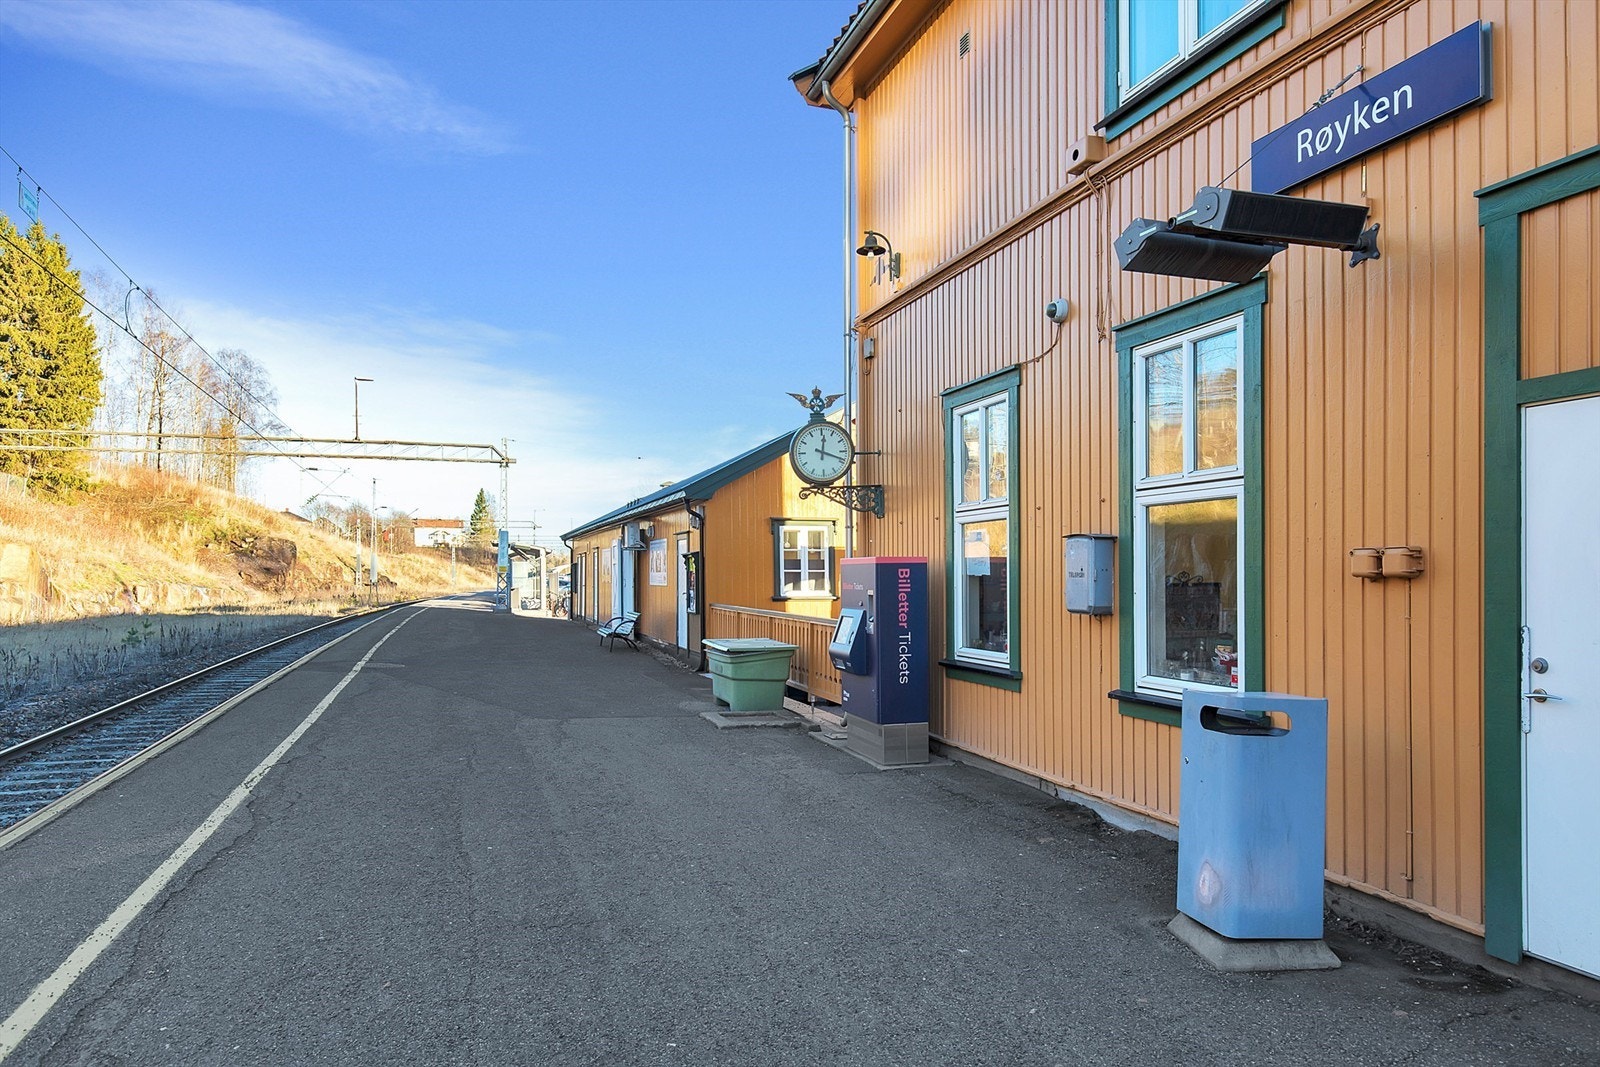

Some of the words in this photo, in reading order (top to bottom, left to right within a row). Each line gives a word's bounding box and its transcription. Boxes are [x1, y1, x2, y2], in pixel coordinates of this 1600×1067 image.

[1297, 84, 1413, 163] Røyken
[898, 568, 911, 628] Billetter
[899, 632, 912, 684] Tickets
